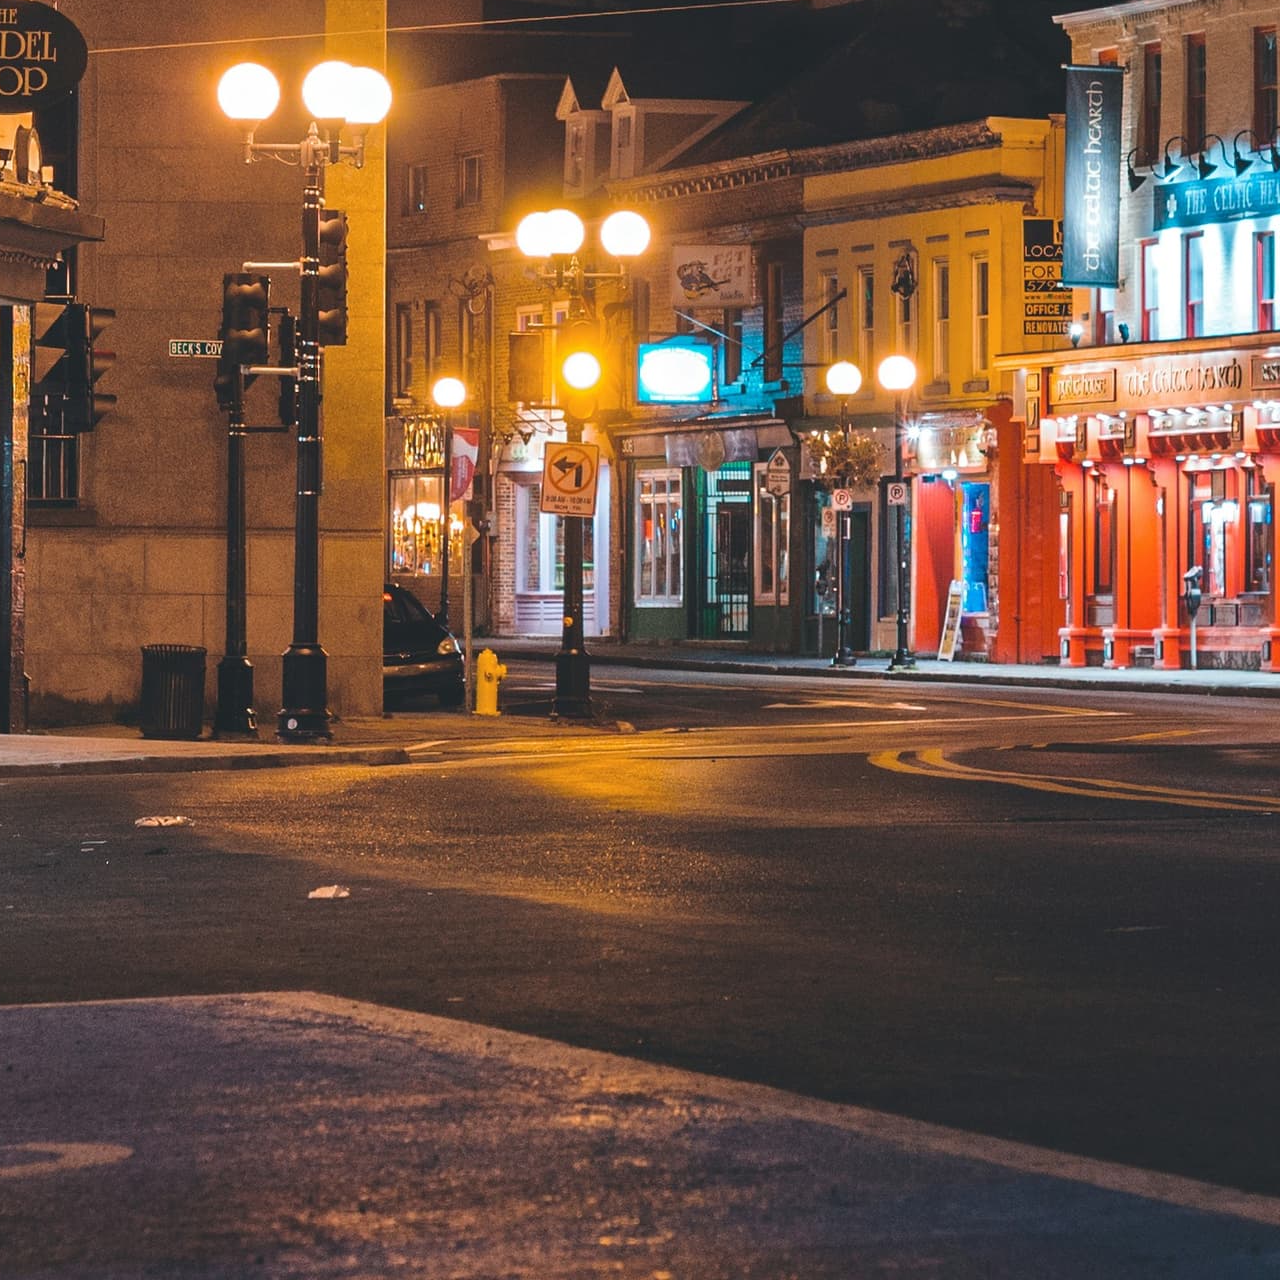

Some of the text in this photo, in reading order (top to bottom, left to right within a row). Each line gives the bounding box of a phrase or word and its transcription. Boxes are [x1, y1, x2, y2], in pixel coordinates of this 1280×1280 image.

[1185, 189, 1207, 215] THE
[1214, 182, 1253, 211] CELTIC
[1024, 266, 1055, 278] FOR
[1026, 304, 1060, 315] OFFICE
[1026, 321, 1072, 334] RENOVATE
[172, 343, 223, 355] BECK'S COV
